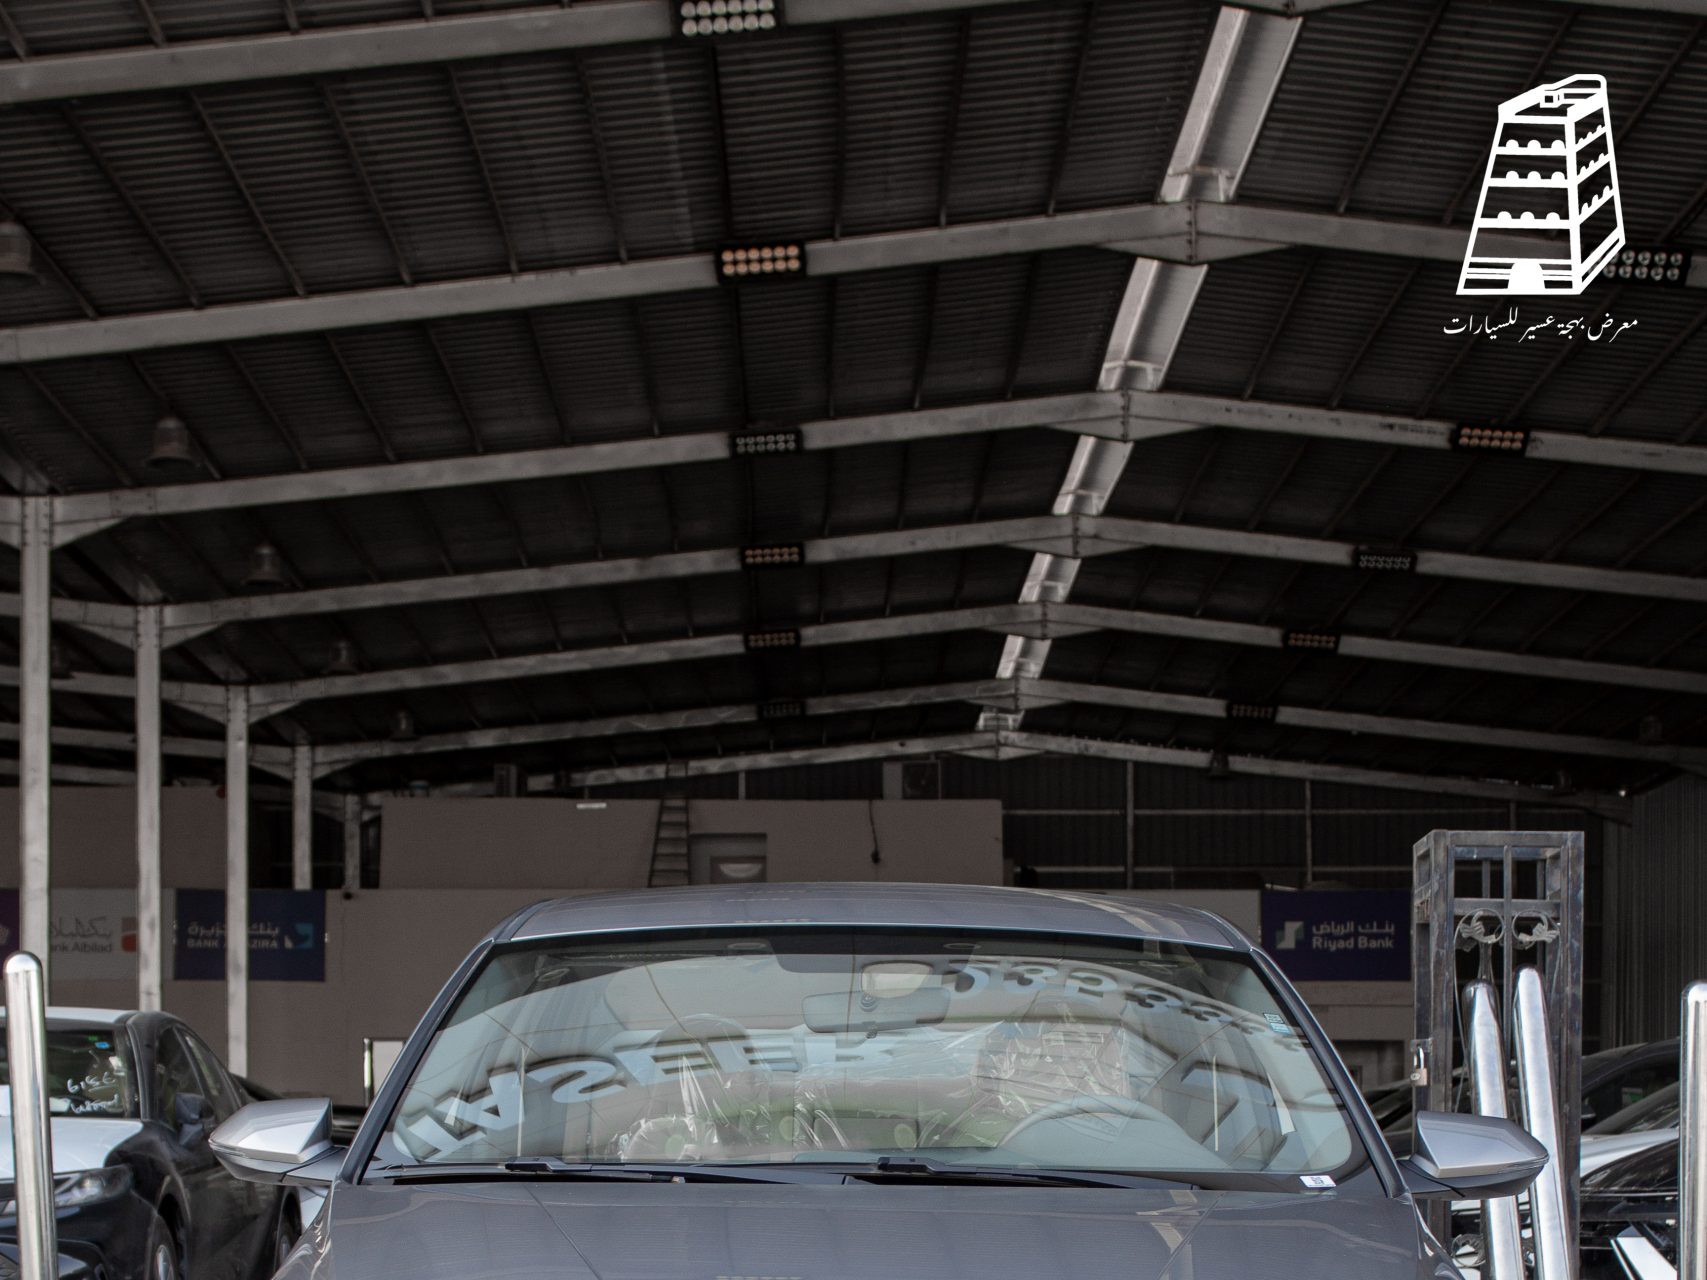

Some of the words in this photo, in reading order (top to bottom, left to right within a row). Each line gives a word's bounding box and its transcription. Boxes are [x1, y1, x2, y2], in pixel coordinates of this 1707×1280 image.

[1312, 920, 1355, 936] الرياض
[1357, 920, 1395, 936] بنك
[186, 936, 218, 948] BANK
[1312, 936, 1355, 952] Riyad
[1357, 936, 1394, 949] Bank
